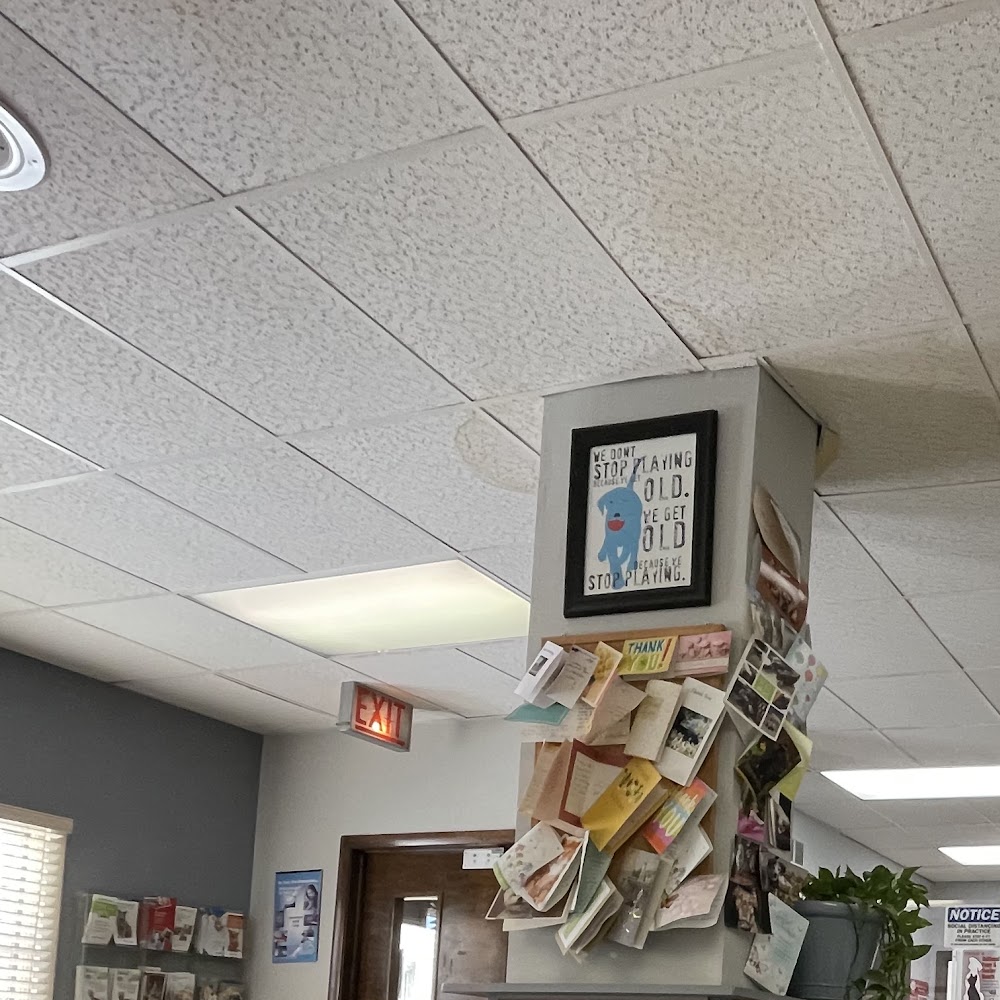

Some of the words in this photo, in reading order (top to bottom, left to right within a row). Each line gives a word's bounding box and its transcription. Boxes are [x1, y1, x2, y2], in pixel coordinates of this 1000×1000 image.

[593, 449, 606, 462] WE
[594, 460, 628, 480] STOP
[633, 450, 692, 474] PLAYING
[644, 474, 690, 502] OLD.
[664, 505, 686, 521] GET
[642, 521, 686, 552] OLD
[588, 572, 620, 590] STOP
[625, 566, 686, 587] PLAYING.
[628, 639, 665, 654] THANK
[355, 686, 406, 738] EXIT
[950, 909, 1000, 921] NOTICE
